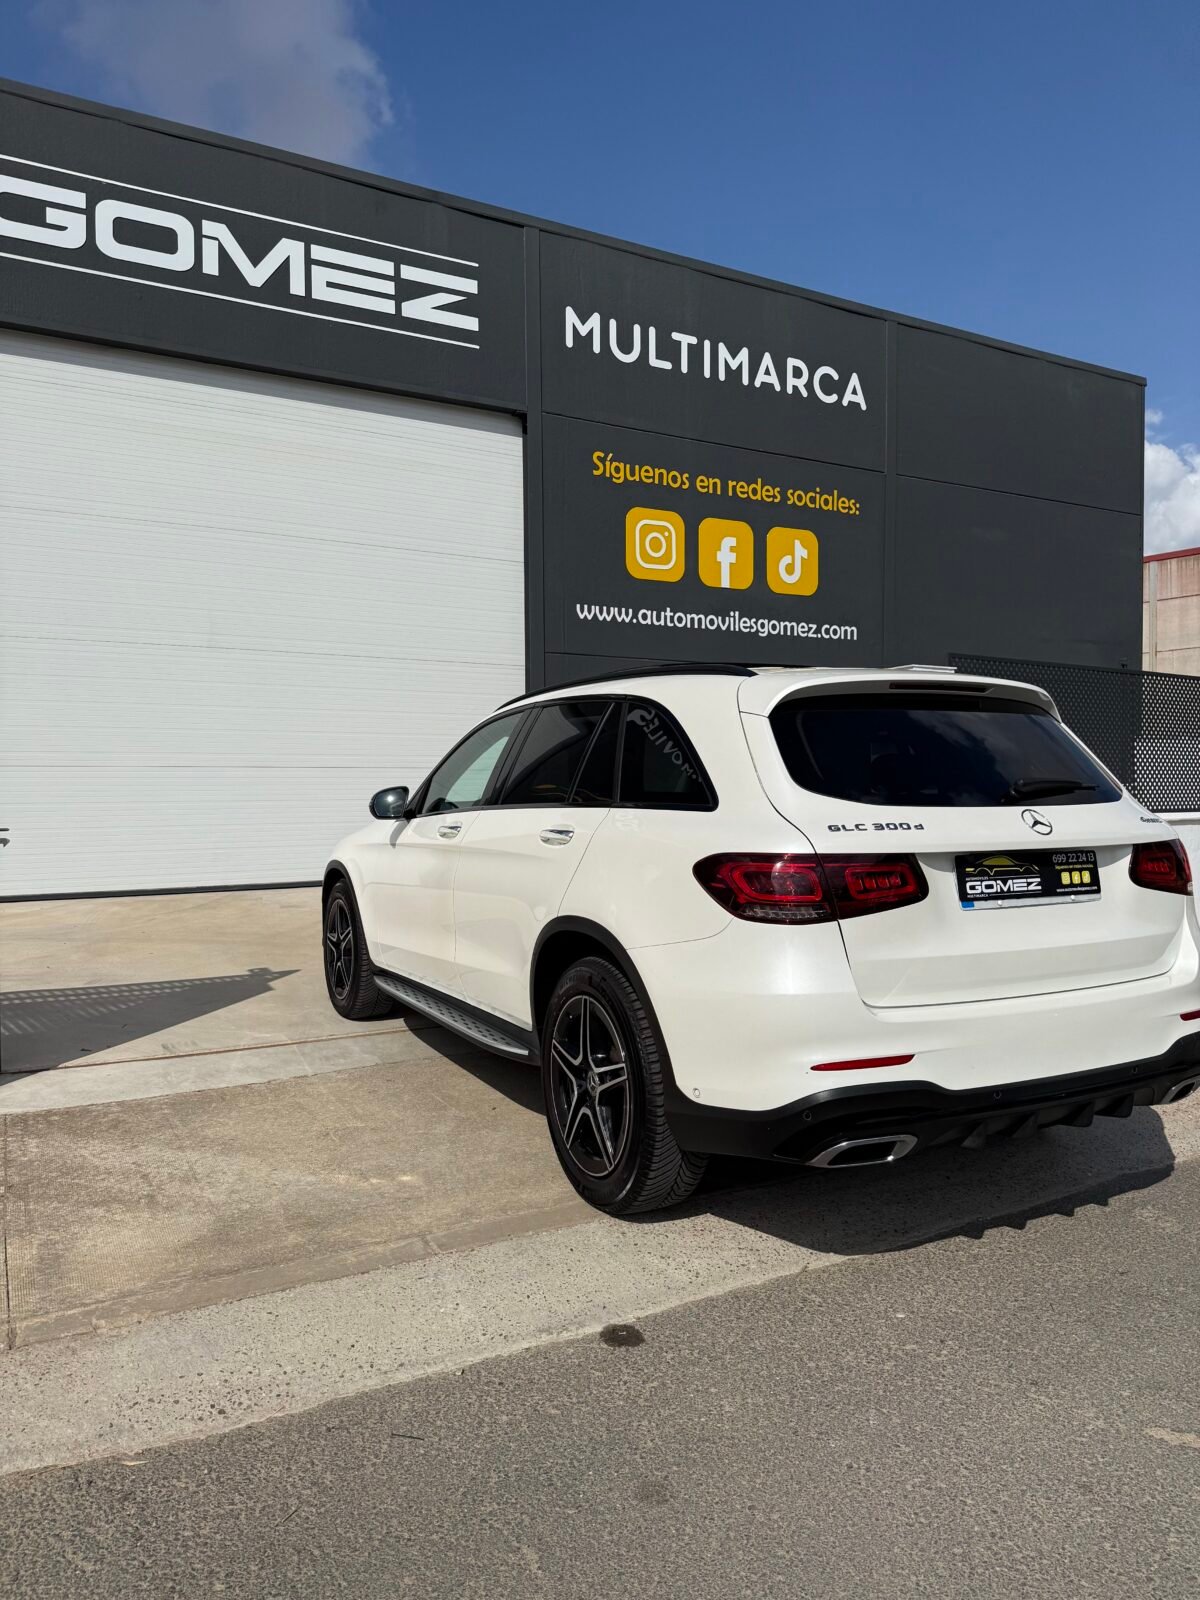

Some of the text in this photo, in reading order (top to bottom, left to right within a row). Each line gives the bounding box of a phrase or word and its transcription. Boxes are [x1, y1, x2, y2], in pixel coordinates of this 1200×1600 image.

[0, 174, 479, 332] GOMEZ
[565, 306, 867, 411] MULTIMARCA
[592, 451, 860, 516] Síguenos en redes sociales:
[576, 603, 858, 641] www.automovilesgomez.com
[827, 823, 868, 832] GLC
[1052, 852, 1095, 863] 699 22 24 13
[965, 878, 1042, 894] GOMEZ
